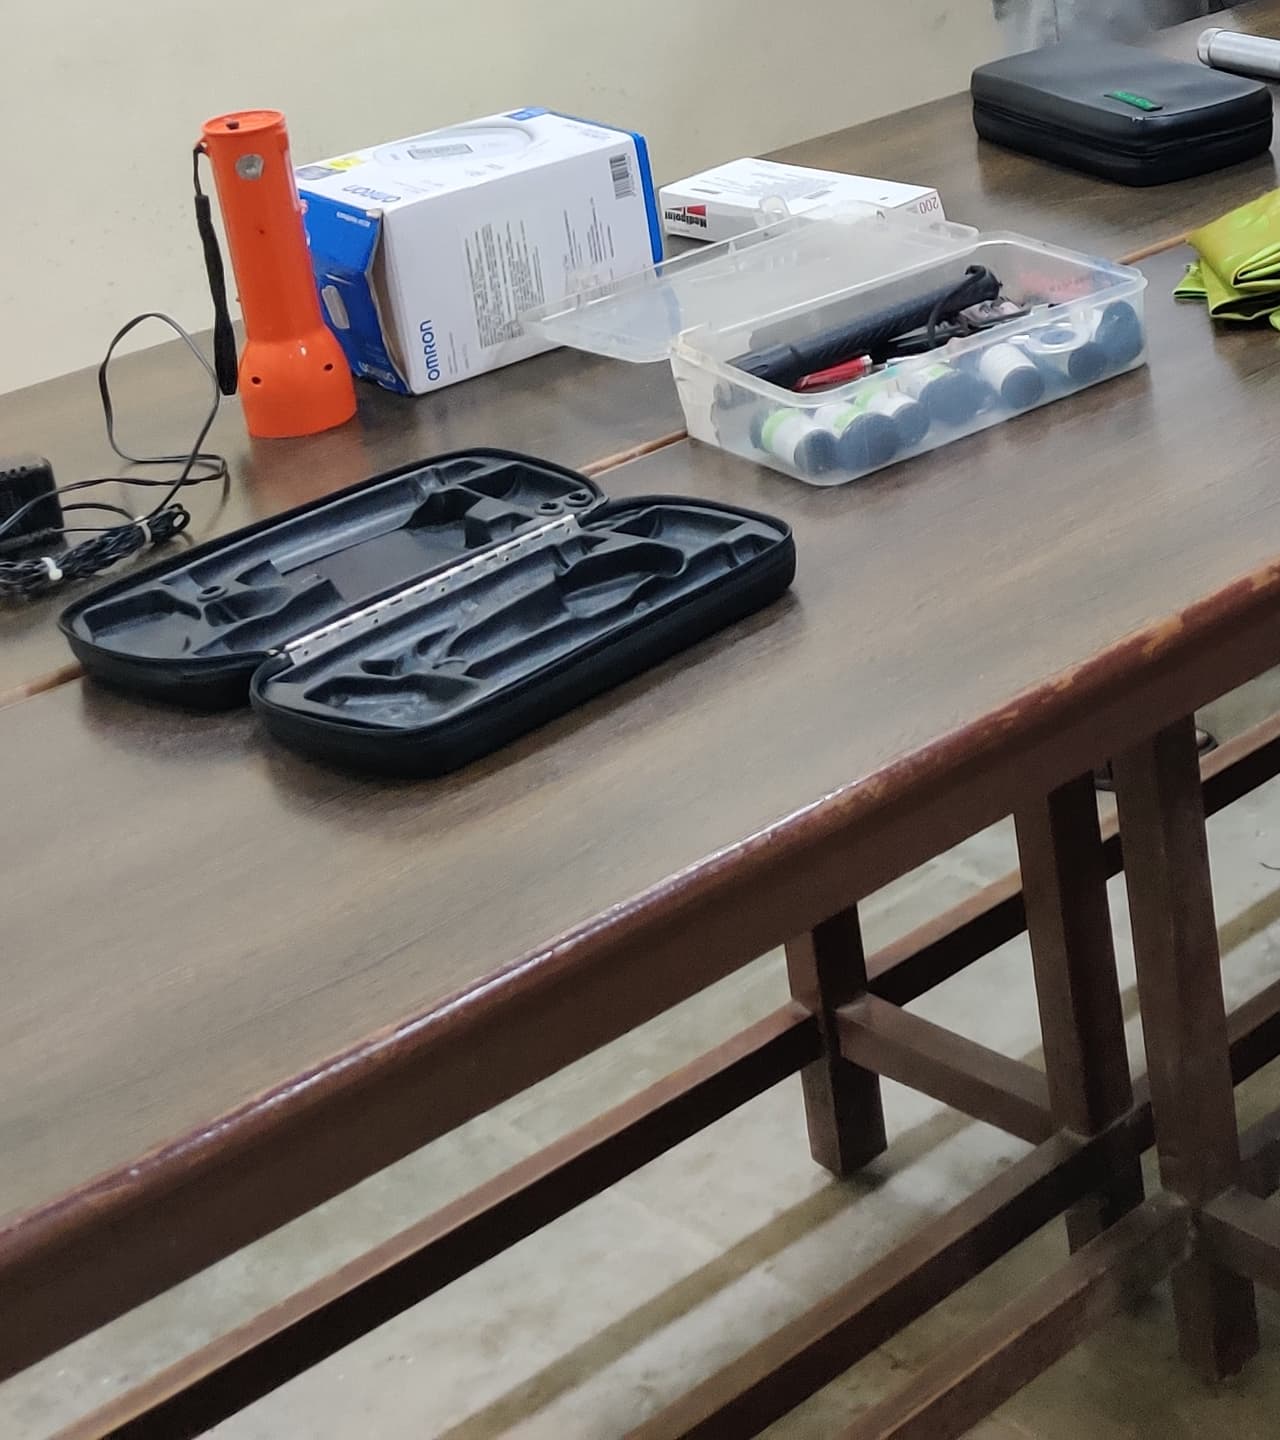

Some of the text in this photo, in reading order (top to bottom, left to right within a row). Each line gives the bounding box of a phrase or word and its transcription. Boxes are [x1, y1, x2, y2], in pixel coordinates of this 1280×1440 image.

[919, 197, 939, 214] 200
[665, 209, 707, 229] Medipoint
[420, 320, 440, 380] OMRON
